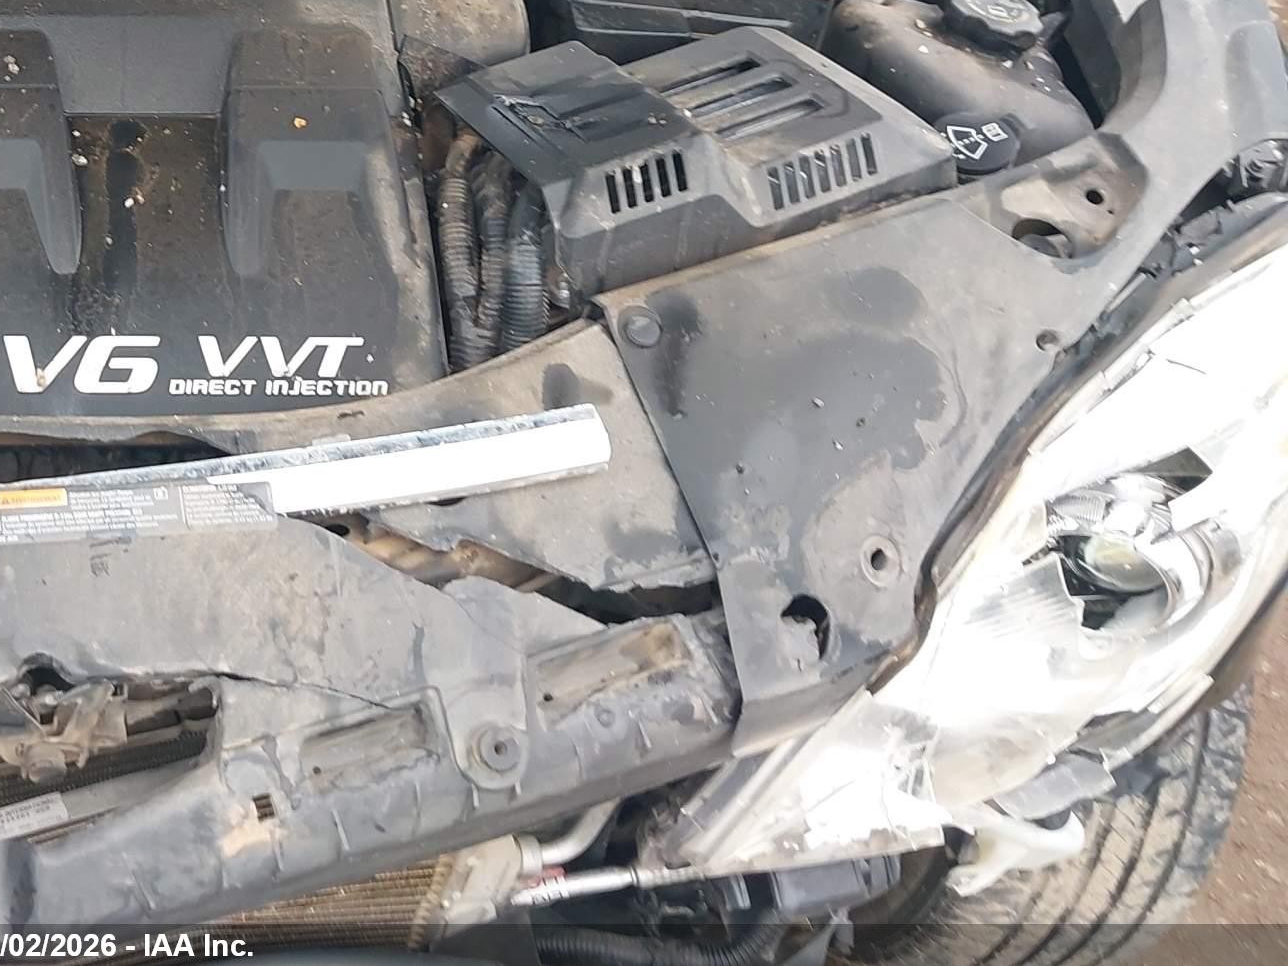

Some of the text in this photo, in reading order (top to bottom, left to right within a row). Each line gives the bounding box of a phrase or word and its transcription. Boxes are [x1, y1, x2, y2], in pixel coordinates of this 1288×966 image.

[3, 335, 365, 394] V6 VVT
[168, 377, 389, 397] DIRECT INJECTION
